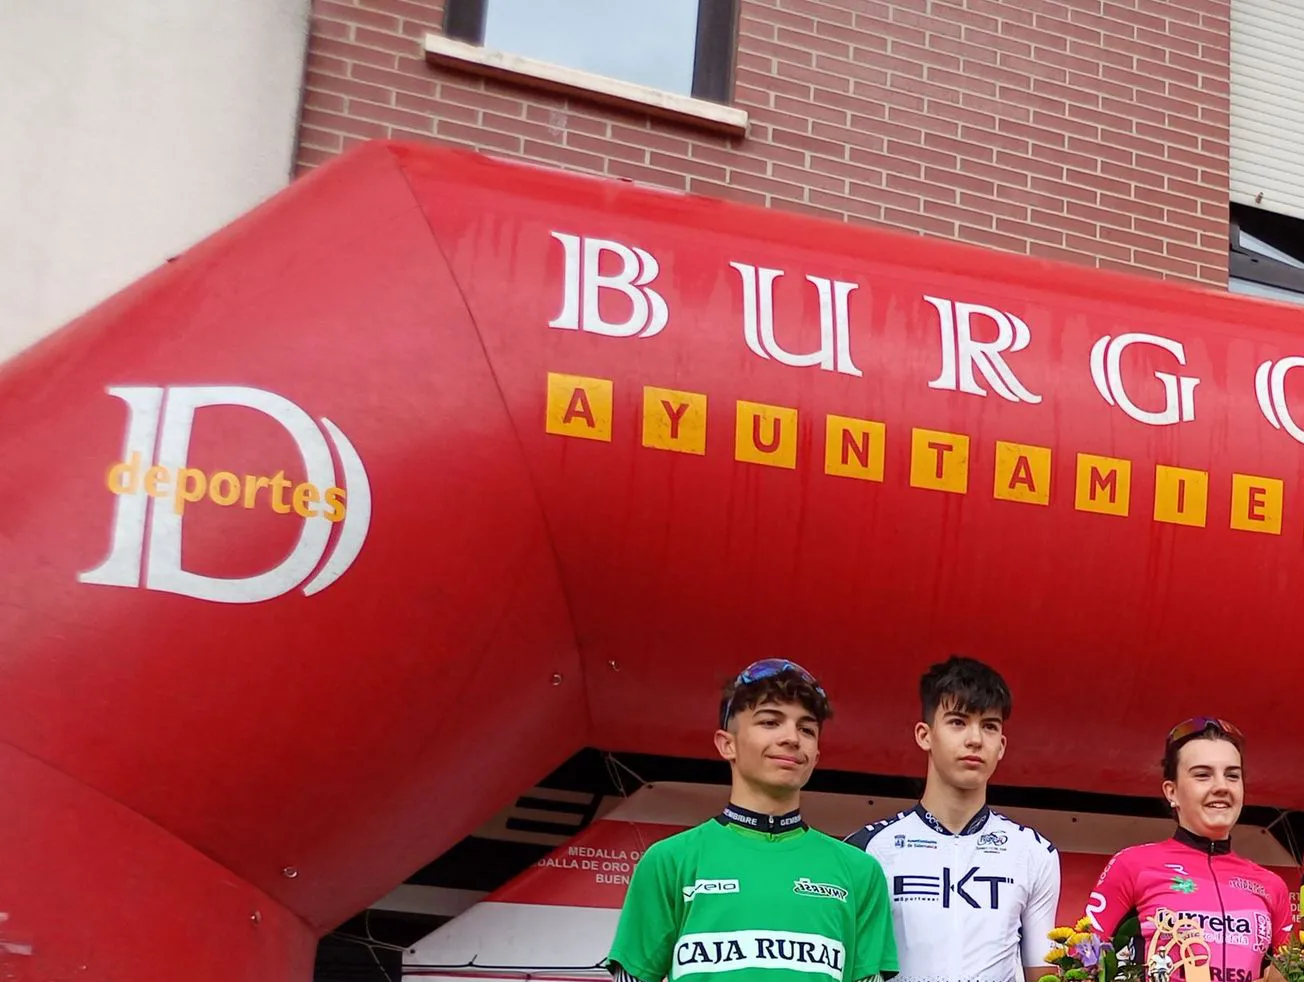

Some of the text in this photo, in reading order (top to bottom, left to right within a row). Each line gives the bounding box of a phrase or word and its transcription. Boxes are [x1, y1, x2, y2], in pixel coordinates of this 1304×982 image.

[107, 451, 349, 523] deportes
[568, 846, 628, 860] MEDALLA
[581, 860, 600, 870] DE
[602, 862, 631, 873] ORO
[677, 937, 843, 973] CAJA RURAL
